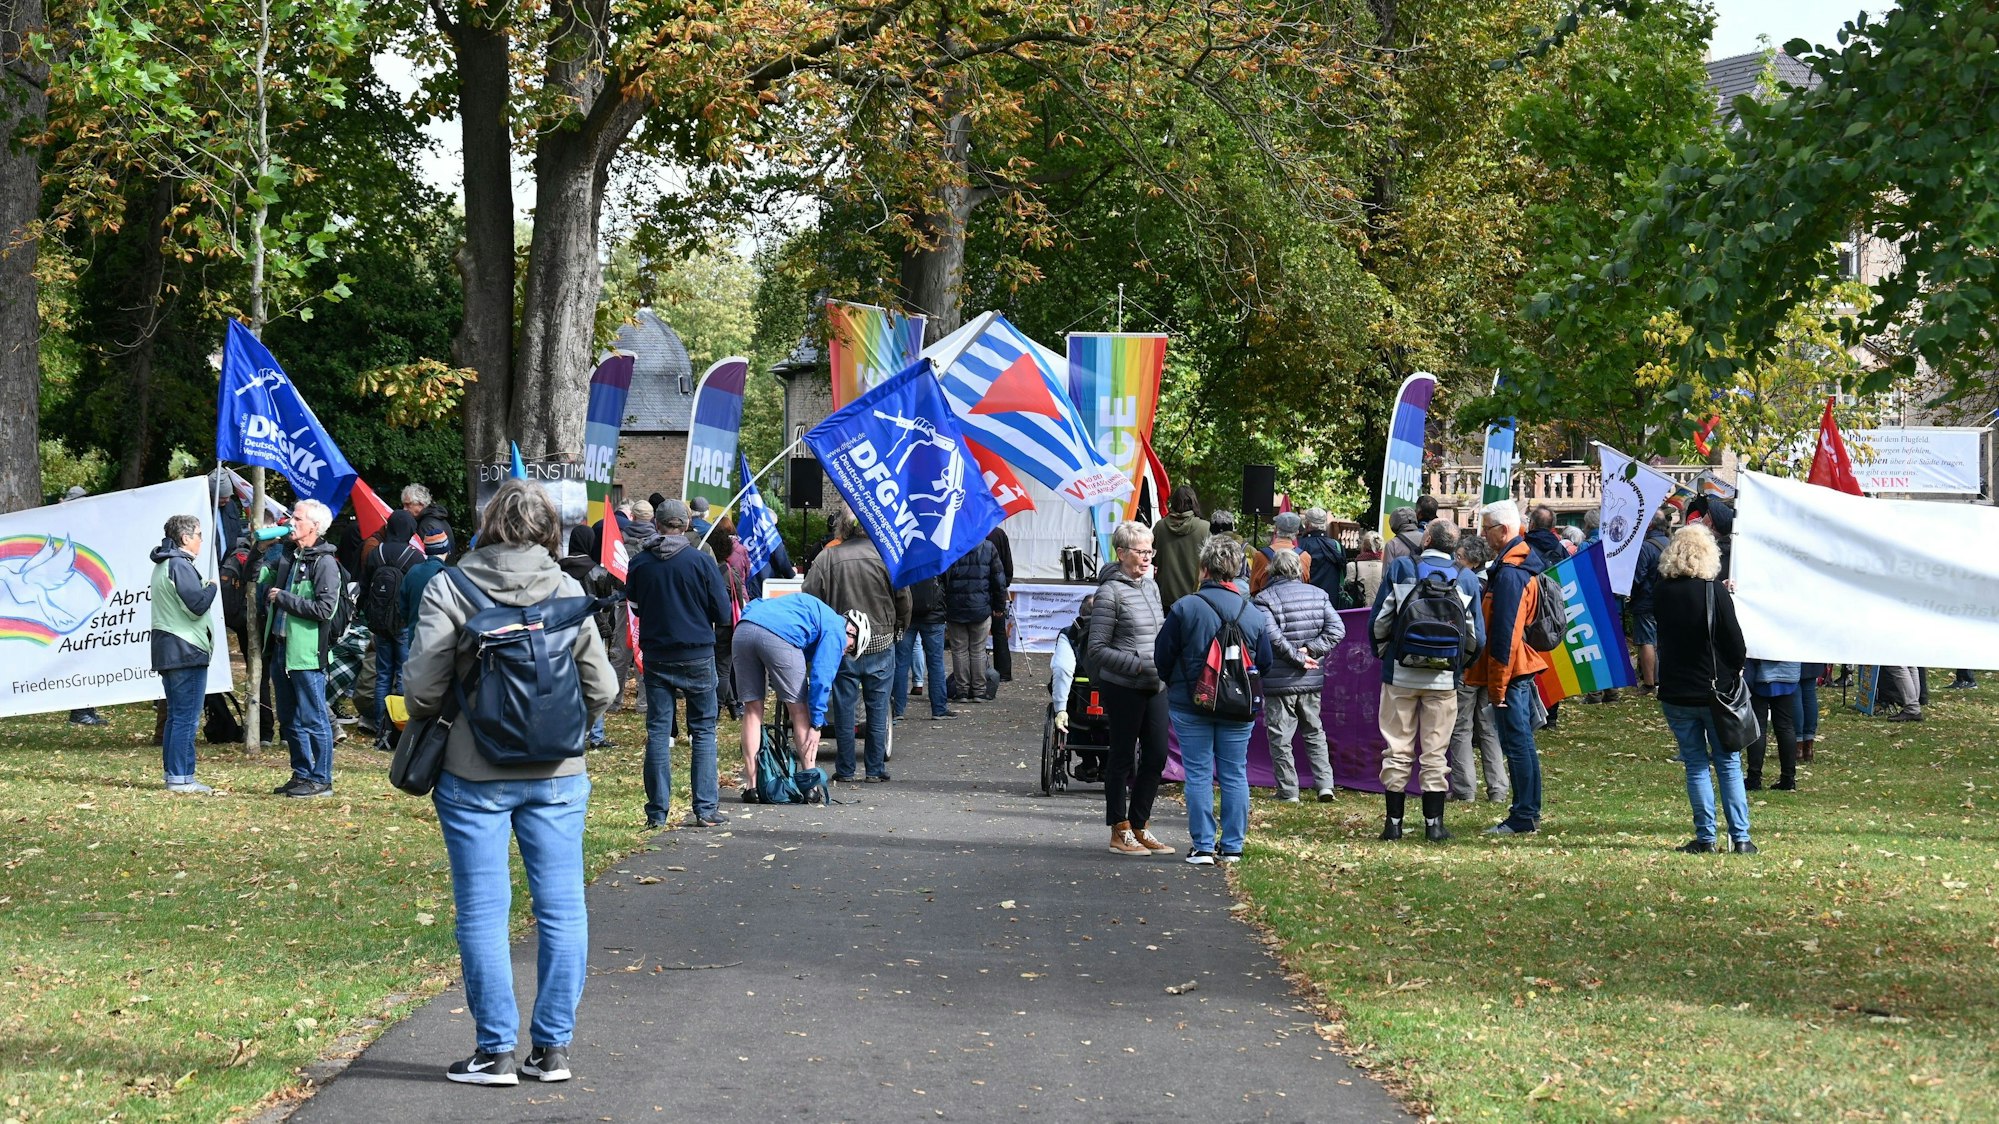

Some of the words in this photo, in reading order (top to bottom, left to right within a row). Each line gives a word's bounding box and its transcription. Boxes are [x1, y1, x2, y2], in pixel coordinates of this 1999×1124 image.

[583, 444, 613, 484] ACE
[689, 445, 733, 489] PACE
[831, 458, 855, 497] Vereinigte
[839, 454, 866, 492] Deutsche
[1387, 459, 1422, 503] PACE
[1866, 468, 1879, 477] gibt
[1871, 477, 1909, 488] NEIN!
[848, 439, 926, 549] DFG-VK
[90, 607, 136, 629] statt
[1560, 581, 1602, 664] PACE
[58, 628, 151, 653] Aufrüstun
